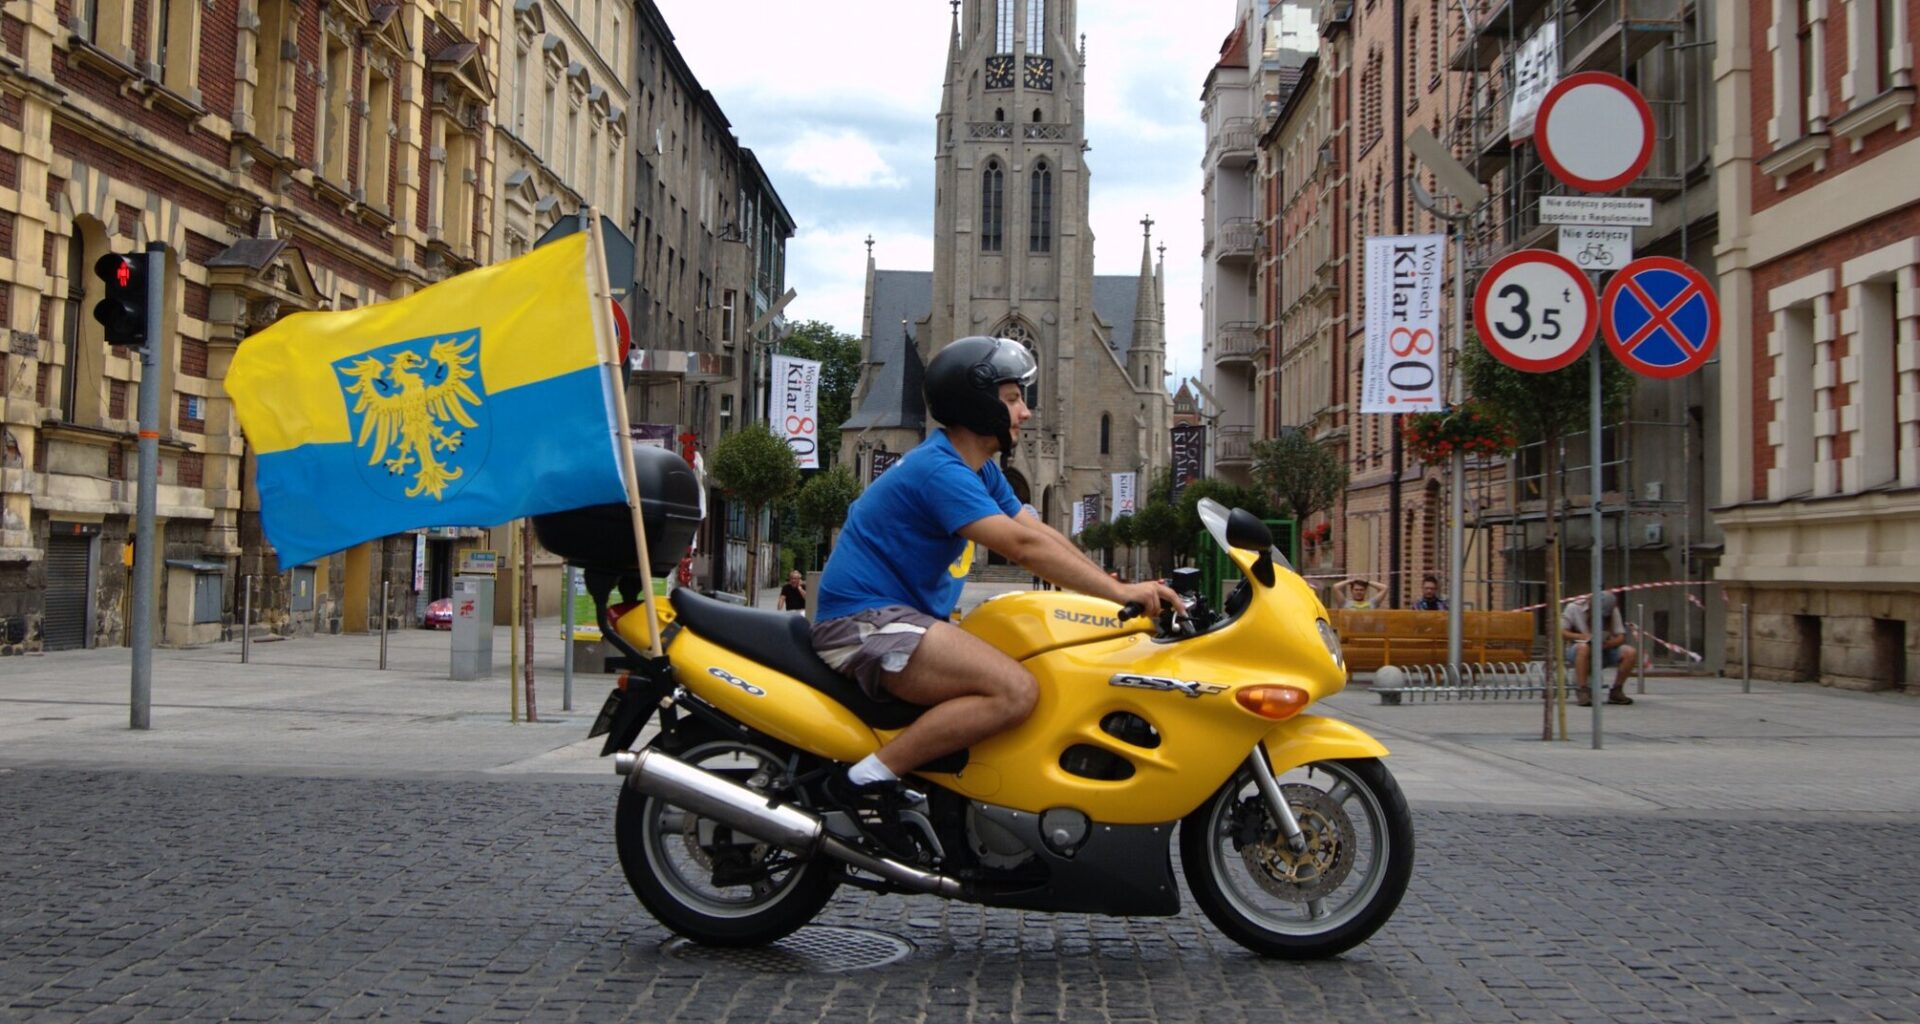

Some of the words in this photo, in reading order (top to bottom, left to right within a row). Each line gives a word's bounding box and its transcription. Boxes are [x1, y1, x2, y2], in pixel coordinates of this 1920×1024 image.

[1542, 213, 1578, 222] zgodnie
[1546, 199, 1561, 207] Nie
[1563, 228, 1582, 238] Nie
[1586, 228, 1629, 241] dotyczy
[1393, 244, 1417, 322] Kilar
[1419, 244, 1436, 320] Wojciech
[1494, 284, 1561, 343] 3,5
[786, 362, 803, 412] Kilar
[804, 365, 817, 412] Wojciech
[1388, 327, 1434, 404] 80!
[1054, 608, 1124, 629] SUZUKI
[708, 667, 764, 696] 600
